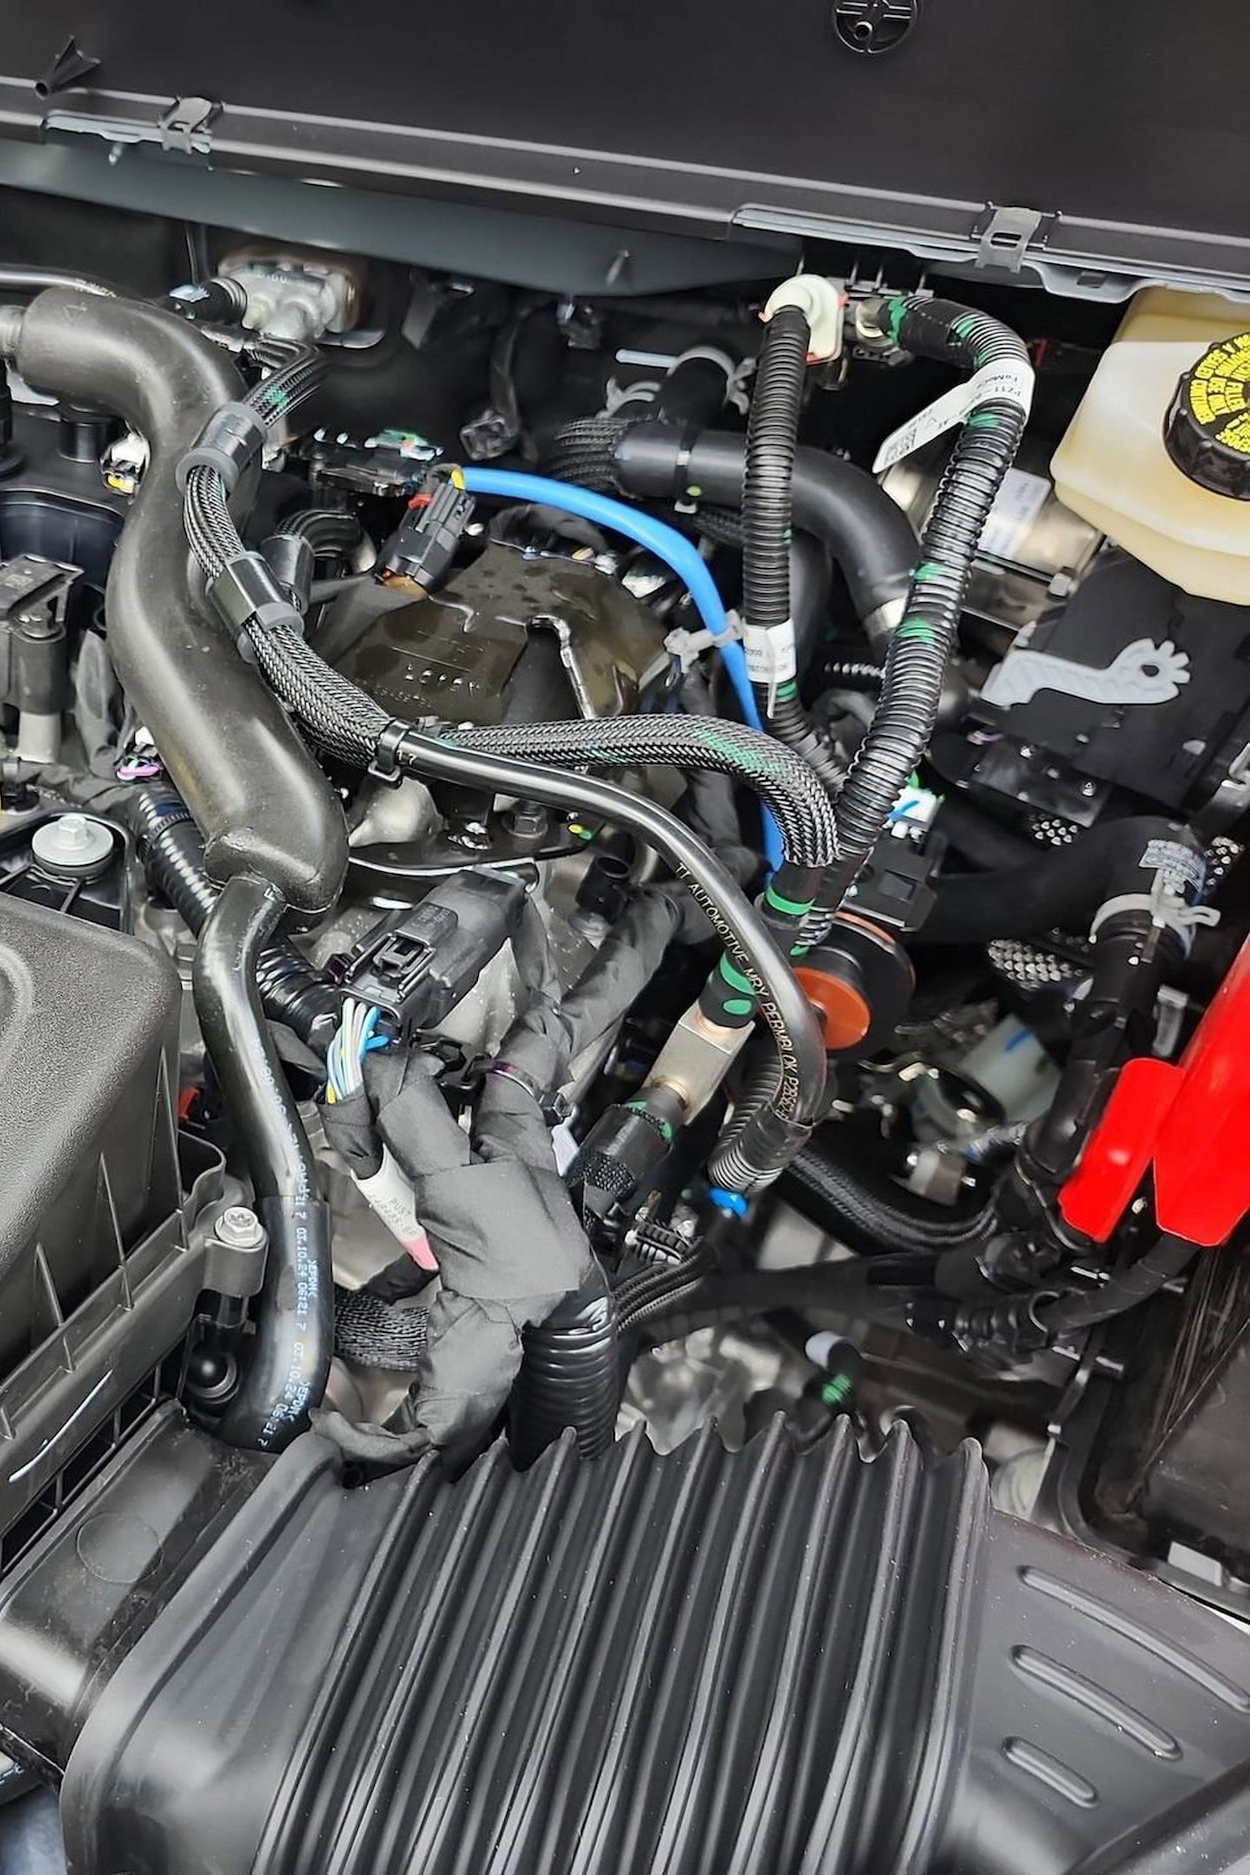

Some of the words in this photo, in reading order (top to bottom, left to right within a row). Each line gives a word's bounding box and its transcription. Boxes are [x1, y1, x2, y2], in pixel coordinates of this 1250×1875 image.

[688, 883, 750, 962] AUTOMOTIVE
[743, 968, 769, 997] MRY
[296, 1227, 308, 1278] 03.10.24
[297, 1282, 308, 1315] 06:21
